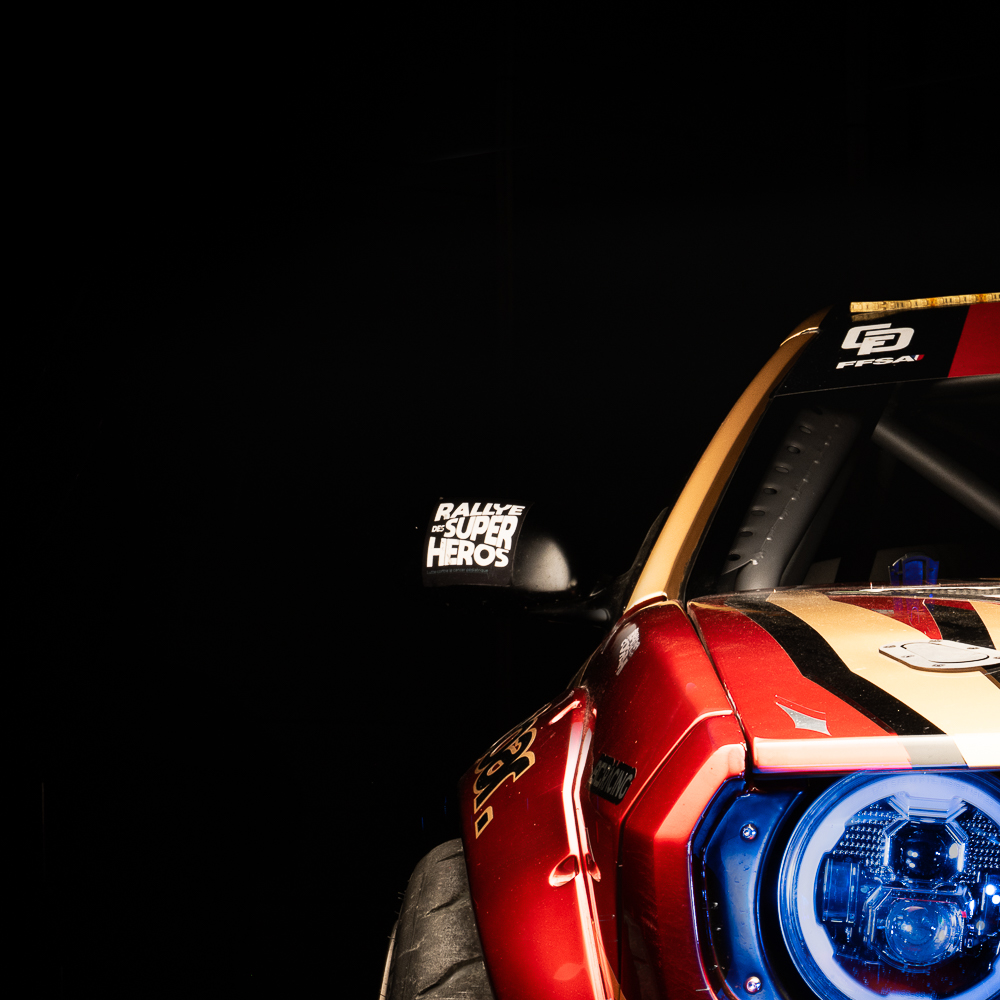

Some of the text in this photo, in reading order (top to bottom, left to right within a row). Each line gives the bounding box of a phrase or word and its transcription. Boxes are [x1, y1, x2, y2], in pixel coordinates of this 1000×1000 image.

[836, 354, 914, 370] FFSA
[433, 502, 526, 522] RALLYE
[431, 514, 519, 551] DES SUPER
[426, 536, 510, 568] HEROS
